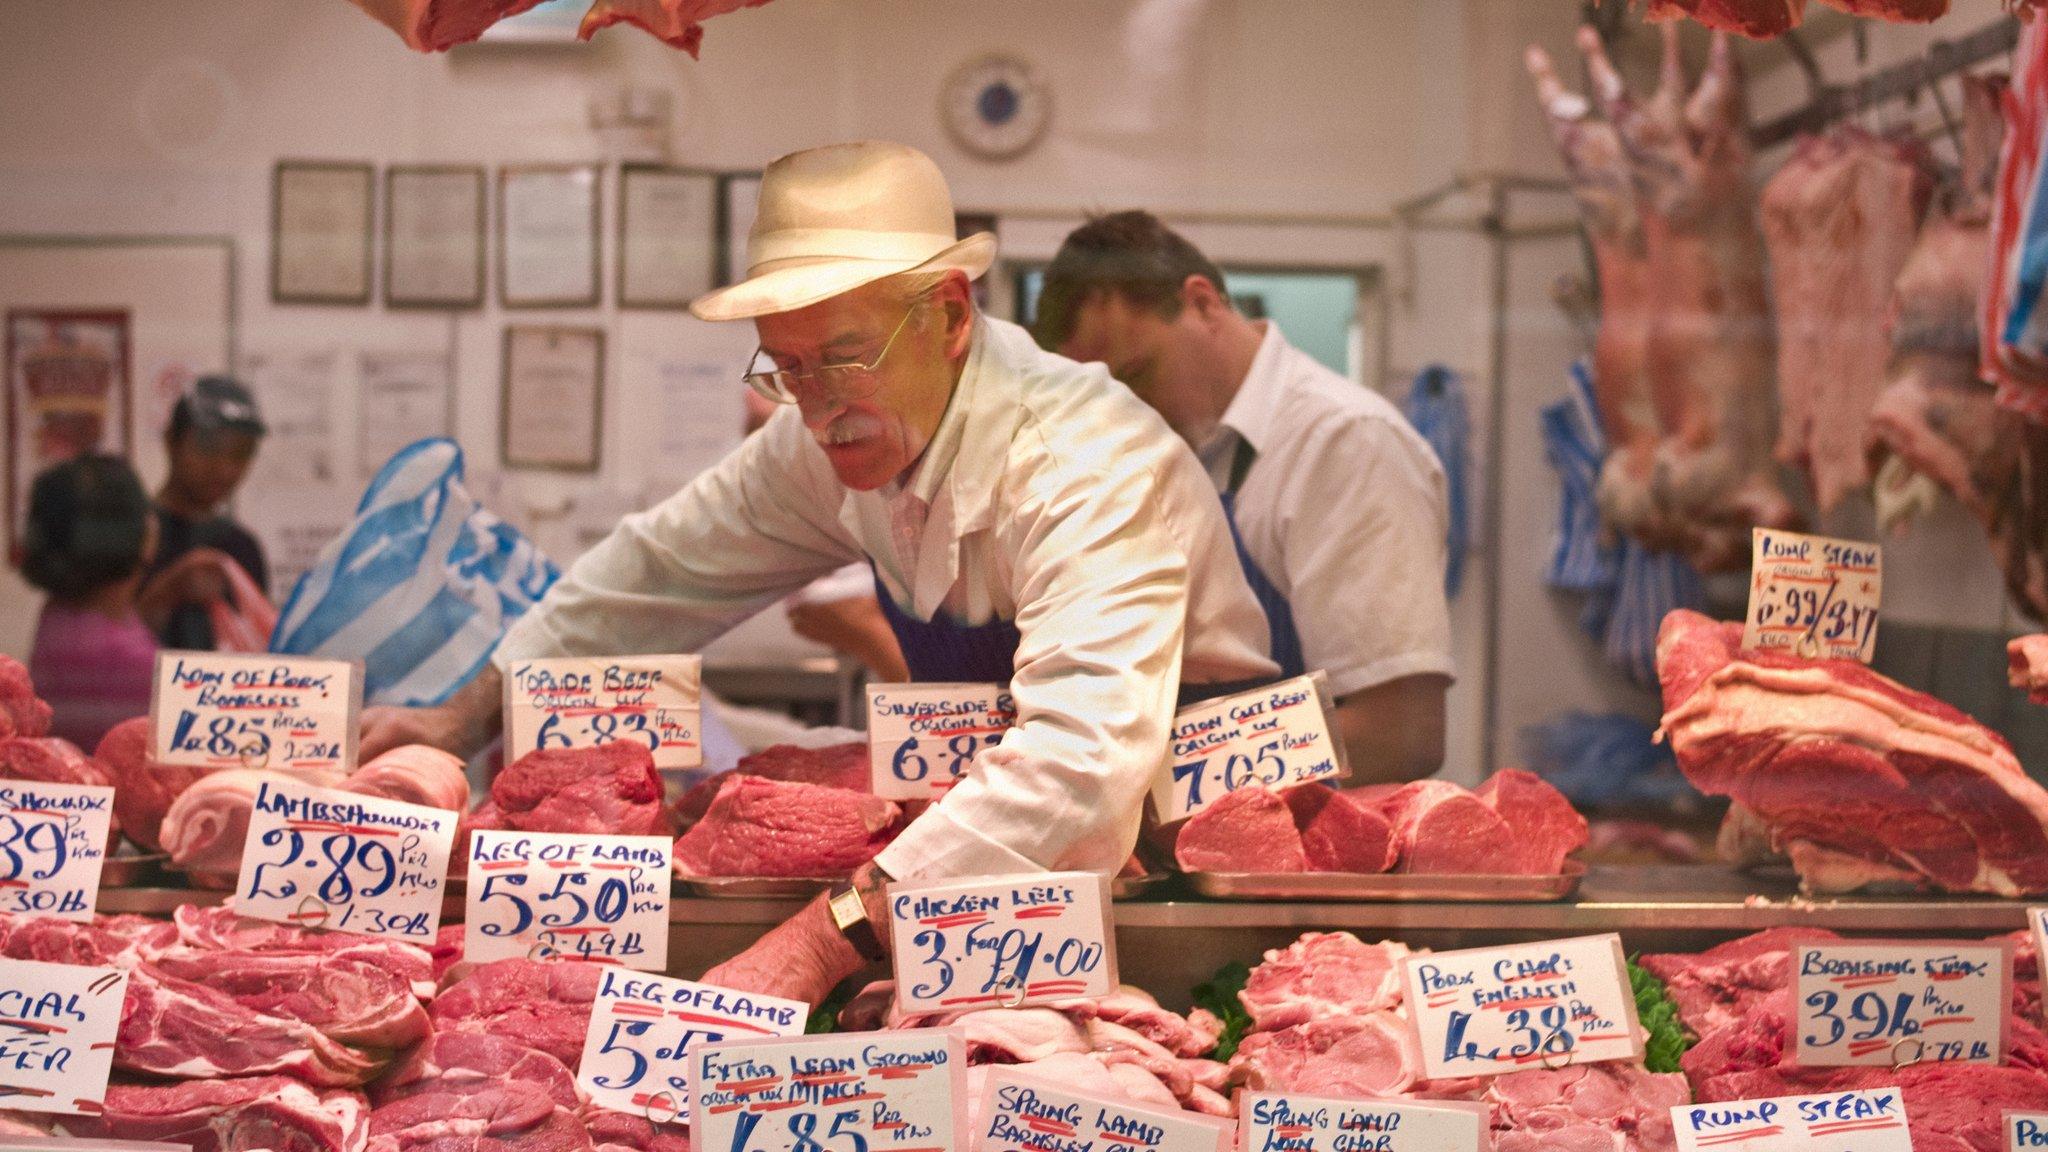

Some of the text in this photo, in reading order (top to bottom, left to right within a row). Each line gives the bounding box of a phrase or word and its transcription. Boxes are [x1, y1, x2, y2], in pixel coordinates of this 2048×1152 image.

[603, 665, 662, 691] BEEF
[616, 693, 646, 707] UK
[874, 694, 989, 716] SILVERSIDE
[247, 828, 396, 905] 2.89
[474, 835, 666, 868] LEG OF LAMB
[894, 894, 1000, 920] CHICKEN
[1802, 949, 1916, 976] BRAISING
[1418, 964, 1474, 995] PORK
[1473, 981, 1577, 1007] ENGLISH
[600, 972, 796, 1026] LEG OF LAMB
[702, 1045, 948, 1081] EXTRA LEAN GROUND
[789, 1081, 867, 1105] MINCE
[997, 1086, 1165, 1145] SPRING LAMB
[1254, 1099, 1401, 1131] SPRING LAMB
[1690, 1093, 1898, 1131] RUMP STEAK
